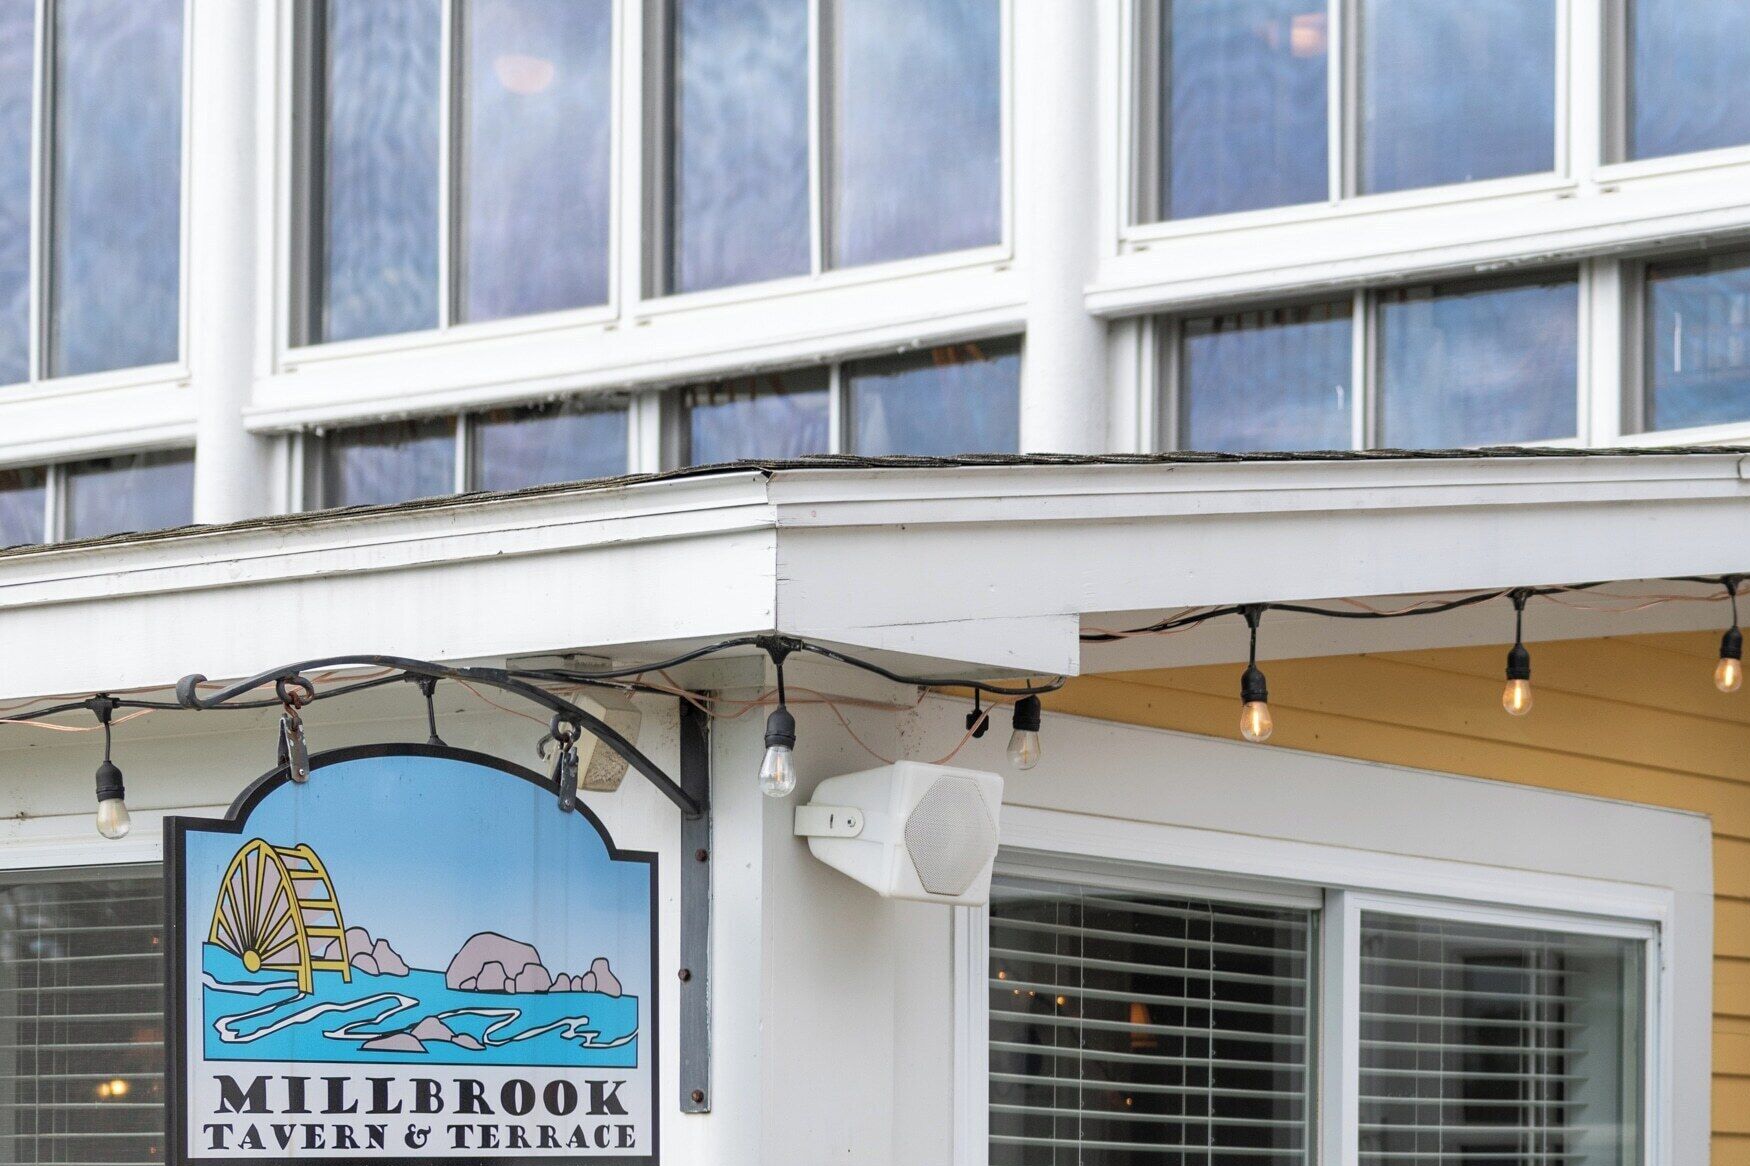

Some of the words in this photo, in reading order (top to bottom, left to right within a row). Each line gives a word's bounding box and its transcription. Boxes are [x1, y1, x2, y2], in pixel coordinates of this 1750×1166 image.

[212, 1074, 629, 1117] MILLBROOK
[203, 1123, 388, 1150] TAVERN
[404, 1124, 432, 1149] &
[446, 1123, 636, 1150] TERRACE
